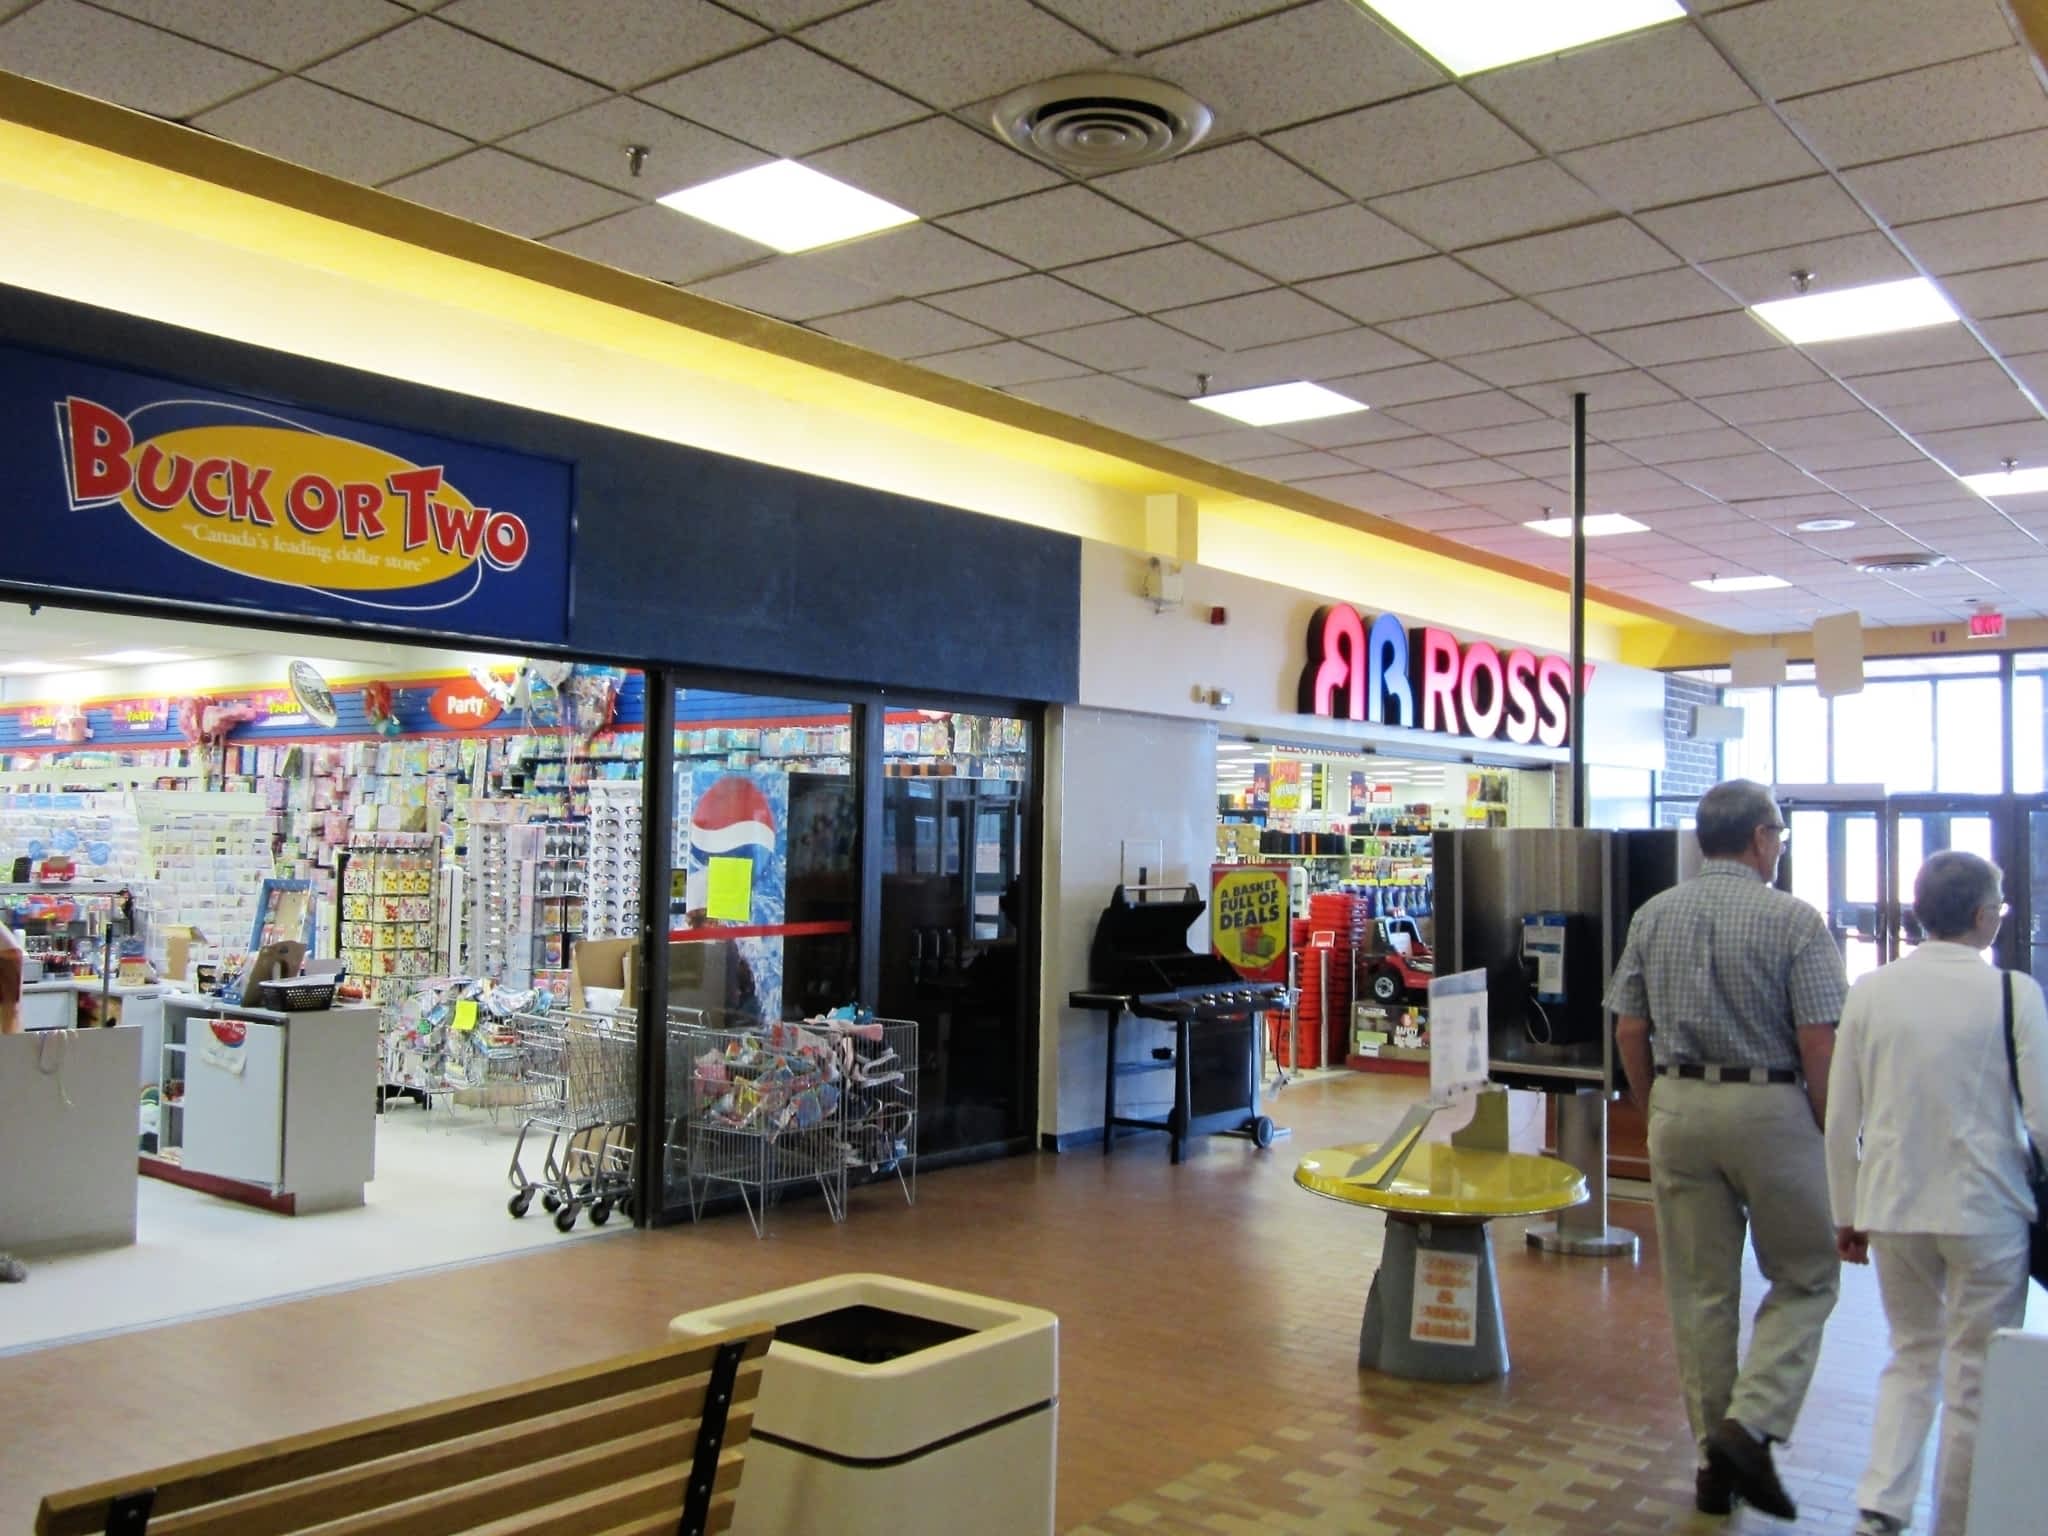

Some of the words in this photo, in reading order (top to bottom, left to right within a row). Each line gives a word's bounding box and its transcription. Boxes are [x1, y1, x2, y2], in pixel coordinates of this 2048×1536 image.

[62, 395, 276, 526] BUCK
[286, 473, 387, 538] OR
[385, 465, 529, 570] TWO
[273, 536, 332, 564] leading
[336, 547, 379, 567] dollar
[1420, 626, 1596, 749] ROSS
[447, 695, 483, 717] Party
[1220, 895, 1254, 912] FULL
[1258, 890, 1279, 905] OF
[1221, 889, 1229, 898] A
[1233, 879, 1277, 896] BASKET
[1220, 905, 1280, 930] DEALS
